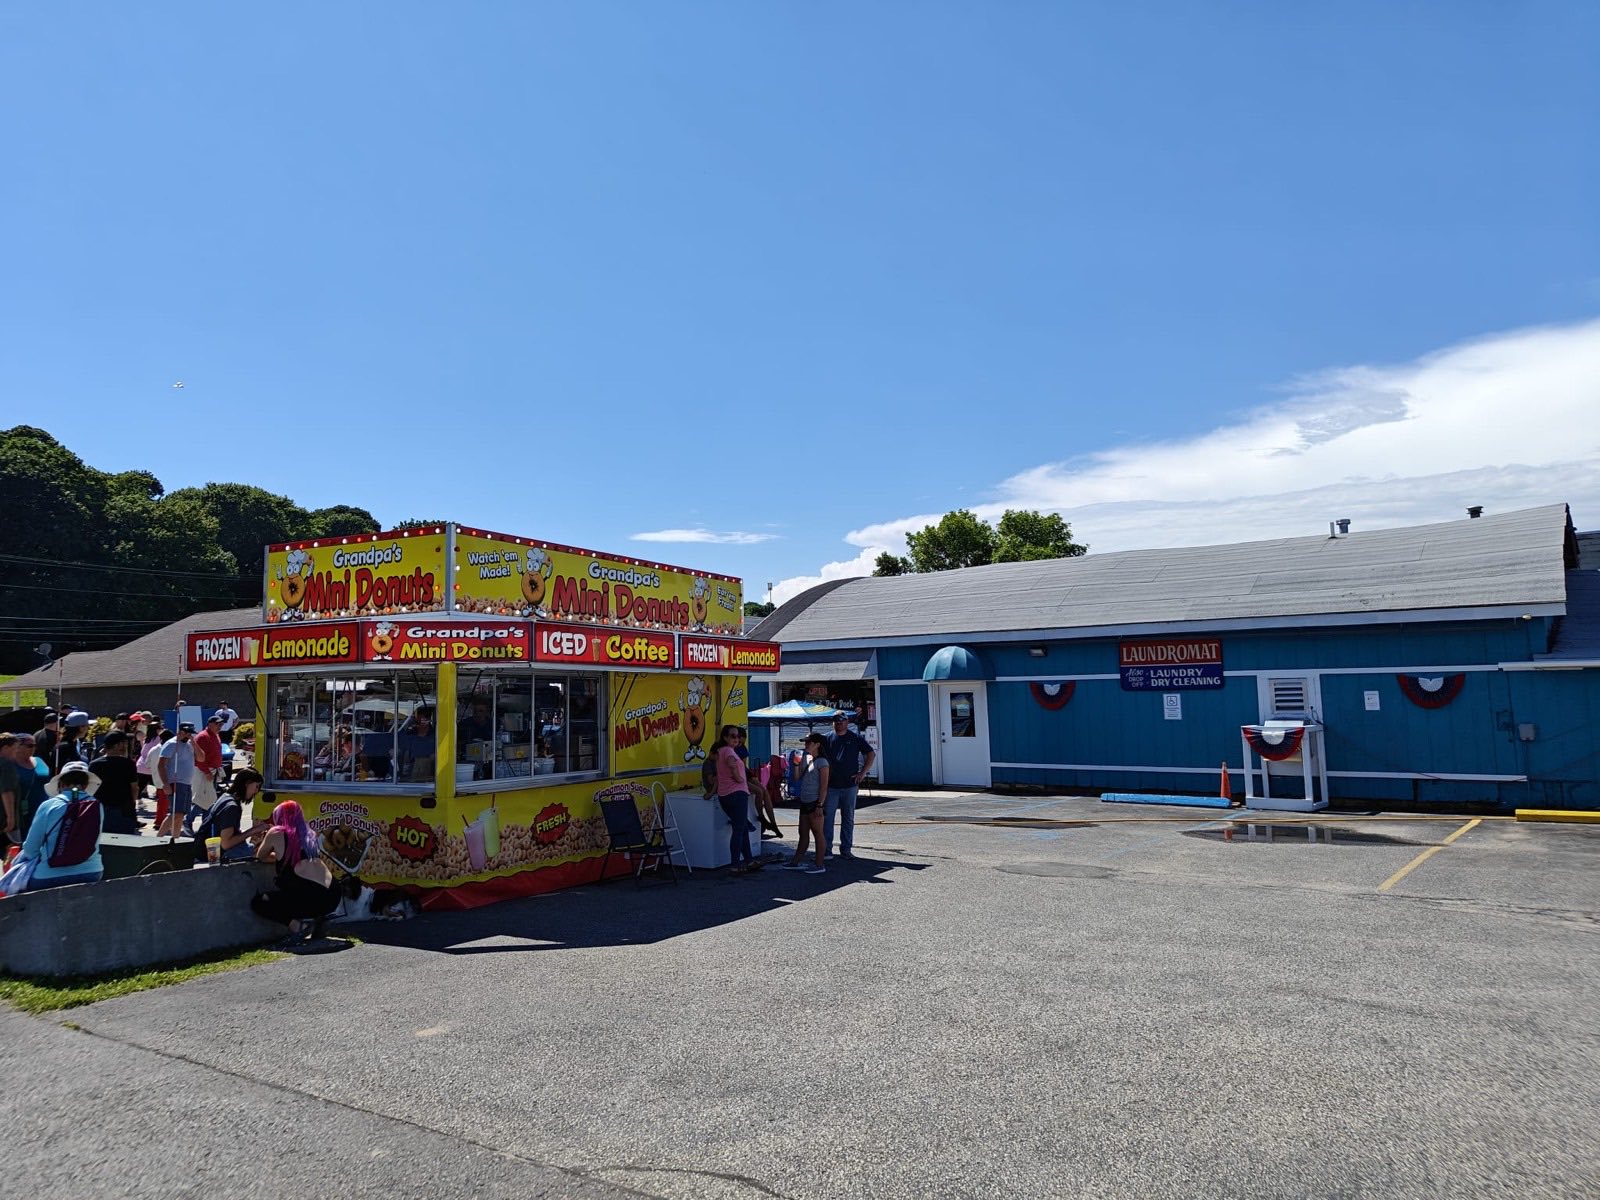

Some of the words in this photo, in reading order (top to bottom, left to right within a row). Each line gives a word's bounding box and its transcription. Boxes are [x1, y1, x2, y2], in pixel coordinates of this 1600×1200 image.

[334, 544, 402, 569] Grandpa's
[468, 552, 501, 565] Watch
[502, 550, 518, 562] 'em
[480, 566, 511, 580] Made!
[588, 561, 661, 588] Grandpa's
[303, 570, 351, 613] Mini
[355, 567, 435, 609] Donuts
[551, 575, 610, 619] Mini
[614, 584, 690, 626] Donuts
[406, 626, 524, 641] Grandpa's
[195, 636, 241, 662] FROZEN
[263, 630, 349, 659] Lemonade
[400, 643, 447, 659] Mini
[452, 642, 524, 659] Donuts
[542, 631, 587, 656] ICED
[605, 635, 669, 662] Coffee
[688, 642, 718, 662] FROZEN
[731, 645, 776, 667] Lemonade
[1122, 643, 1219, 663] LAUNDROMAT
[1150, 668, 1204, 678] LAUNDRY
[1151, 678, 1171, 687] DRY
[1173, 676, 1221, 686] CLEANING
[625, 699, 668, 721] Grandpa's
[615, 721, 641, 752] Mini
[641, 711, 680, 742] Donuts
[320, 801, 369, 816] Chocolate
[345, 816, 380, 836] Donuts
[536, 813, 567, 834] FRESH
[397, 826, 429, 849] HOT
